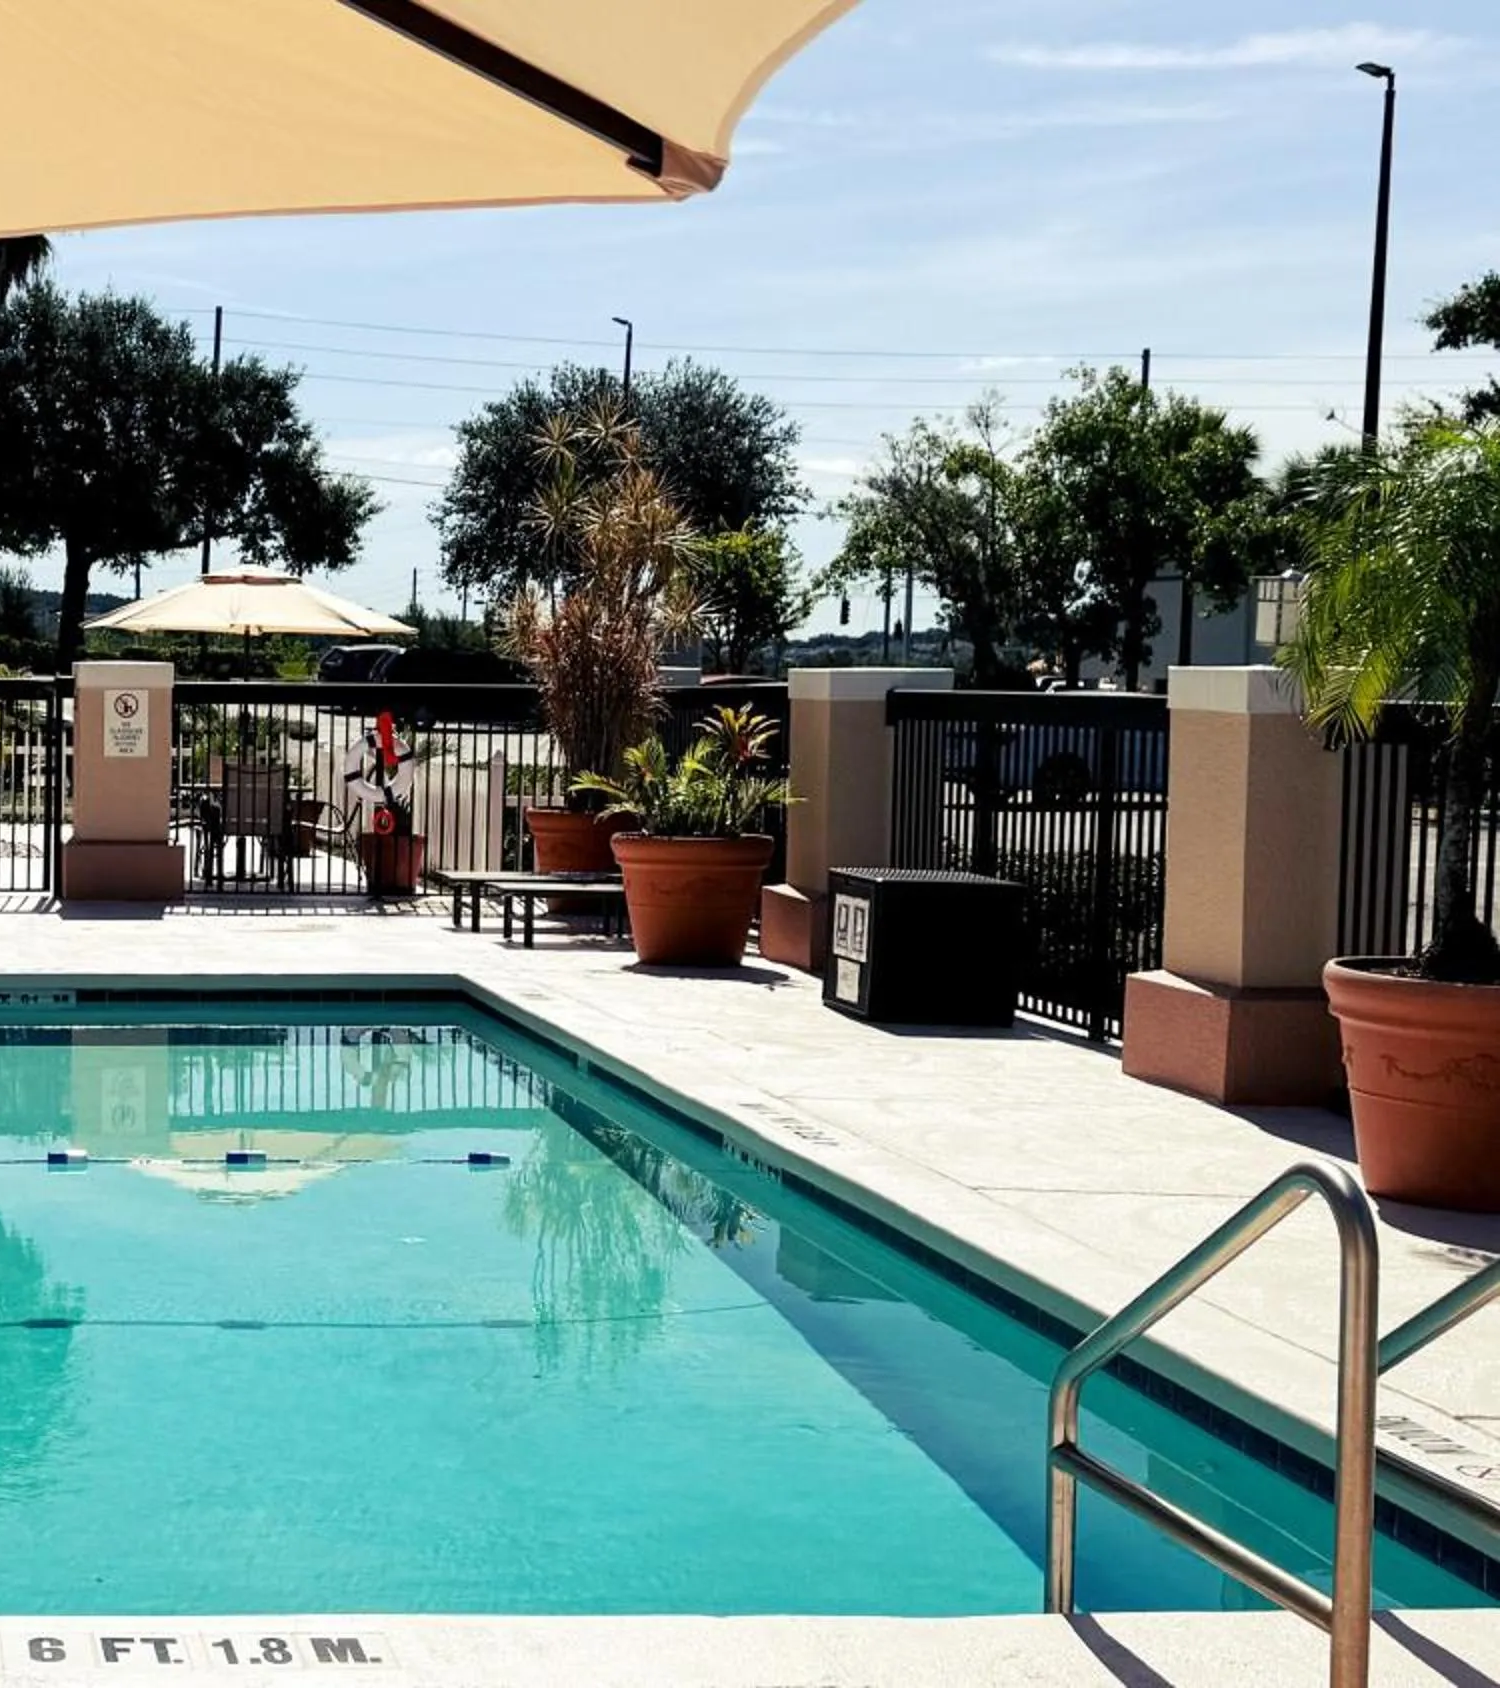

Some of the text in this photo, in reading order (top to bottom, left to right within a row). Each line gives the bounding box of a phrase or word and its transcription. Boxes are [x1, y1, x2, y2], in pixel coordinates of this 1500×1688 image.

[26, 1636, 383, 1665] 6 FT. 1.8 M.
